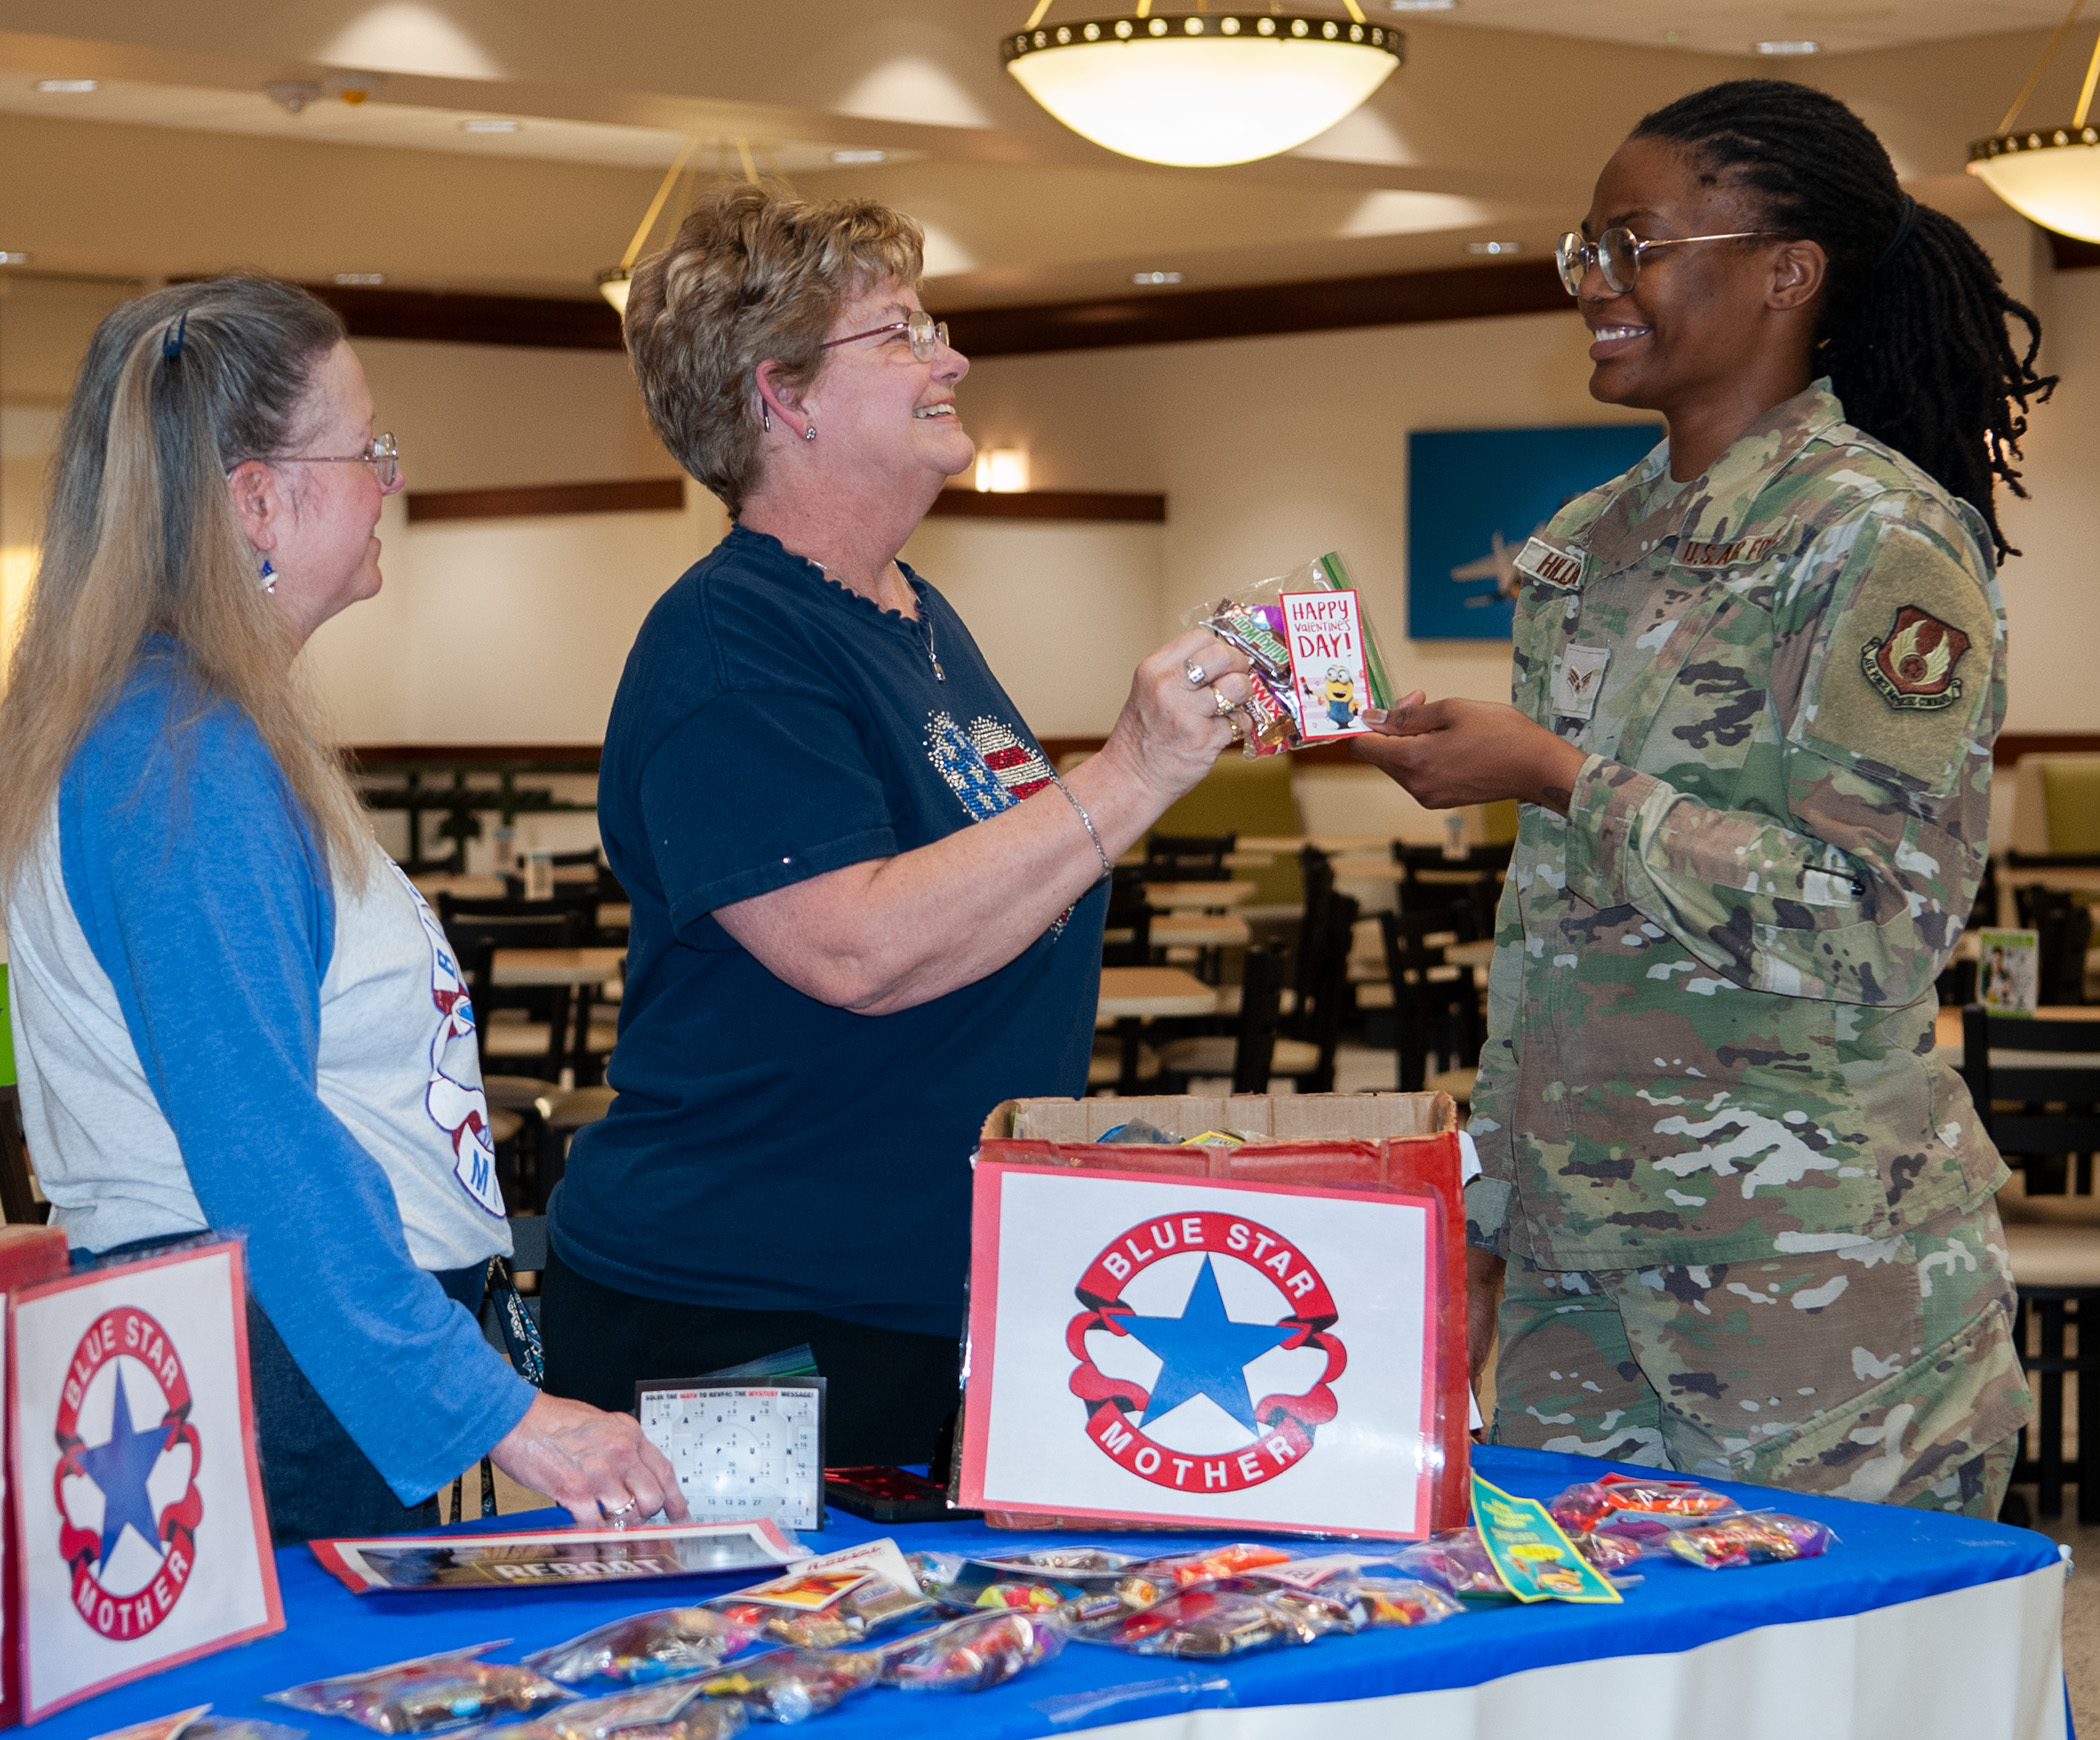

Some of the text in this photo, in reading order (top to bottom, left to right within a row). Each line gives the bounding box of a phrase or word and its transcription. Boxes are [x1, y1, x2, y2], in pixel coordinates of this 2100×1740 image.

[1683, 541, 1716, 565] U.S.
[1292, 600, 1348, 620] HAPPY
[1229, 614, 1290, 665] Milky Way
[1298, 632, 1351, 658] DAY!
[1102, 1217, 1316, 1299] BLUE STAR
[65, 1316, 178, 1411] BLUE STAR
[1100, 1420, 1296, 1489] MOTHER
[77, 1550, 188, 1636] MOTHER
[493, 1559, 664, 1580] REBOOT
